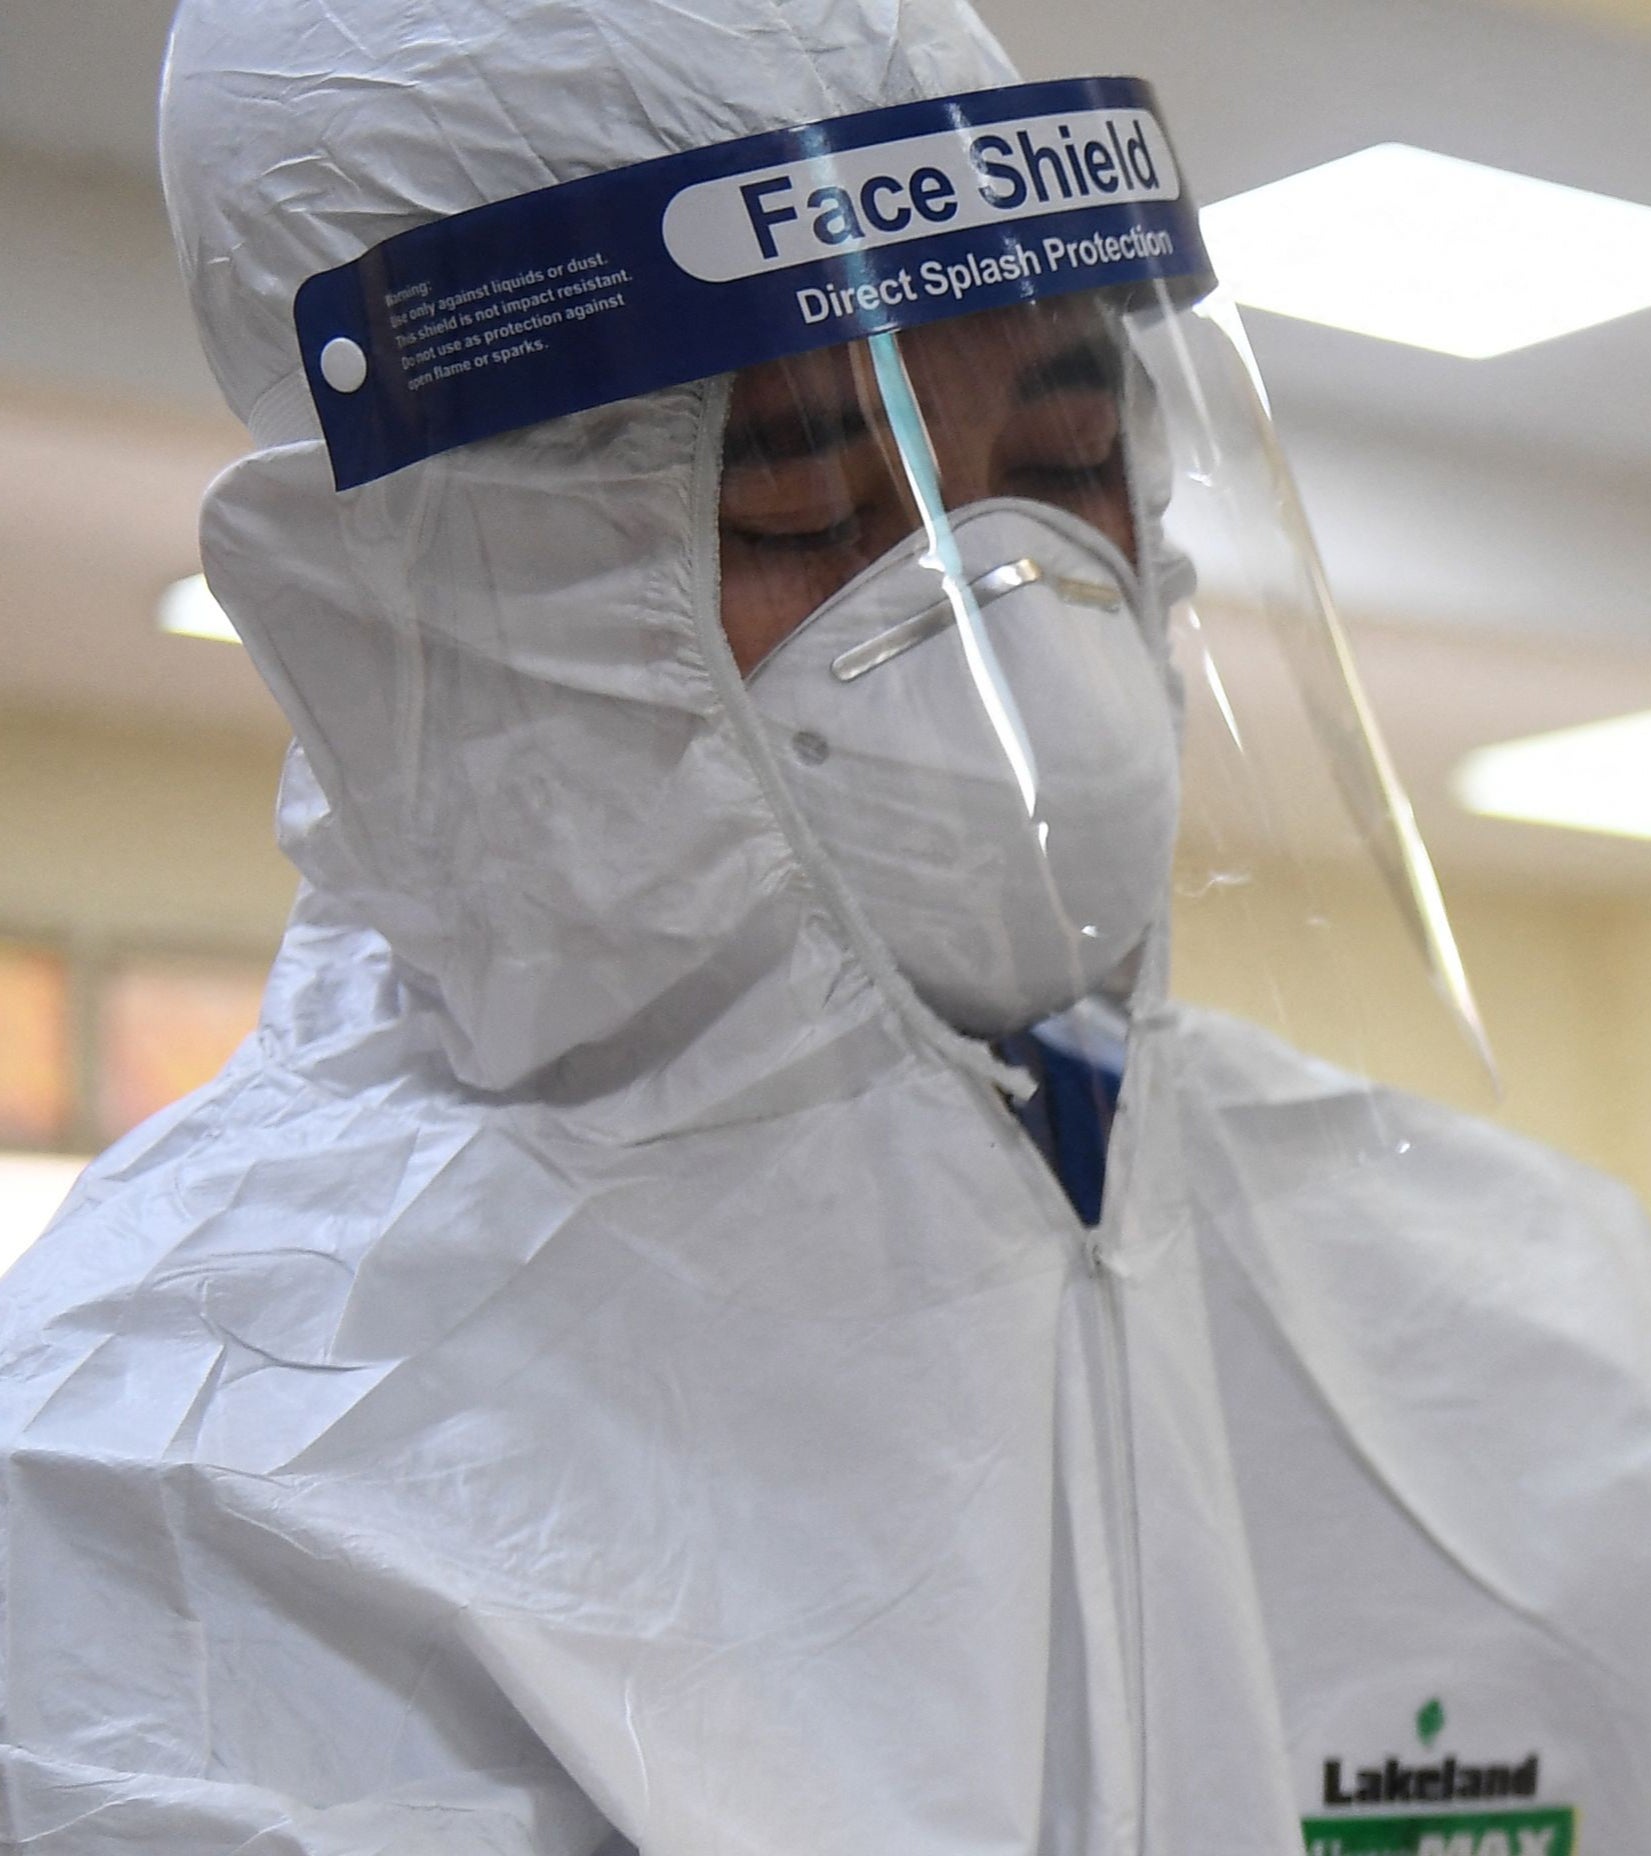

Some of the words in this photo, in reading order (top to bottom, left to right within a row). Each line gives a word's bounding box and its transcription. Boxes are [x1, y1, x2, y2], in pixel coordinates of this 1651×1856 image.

[739, 164, 959, 261] Face
[969, 119, 1161, 211] Shield
[395, 332, 417, 349] This
[417, 316, 458, 340] shield
[459, 313, 473, 326] is
[474, 303, 501, 321] not
[501, 288, 556, 314] impact
[557, 269, 633, 299] resistant.
[409, 302, 435, 320] only
[438, 284, 491, 311] against
[491, 269, 545, 294] liquids
[546, 264, 564, 279] or
[567, 252, 609, 273] dust.
[796, 271, 917, 326] Direct
[918, 243, 1043, 300] Splash
[1046, 223, 1174, 273] Protection
[401, 355, 416, 370] Do
[416, 346, 436, 364] not
[437, 340, 463, 356] use
[464, 334, 483, 348] as
[483, 312, 563, 346] protection
[565, 292, 625, 321] against
[407, 372, 433, 391] open
[433, 359, 472, 380] flame
[474, 354, 489, 368] or
[491, 338, 549, 364] sparks.
[1323, 1752, 1538, 1806] Lakeland
